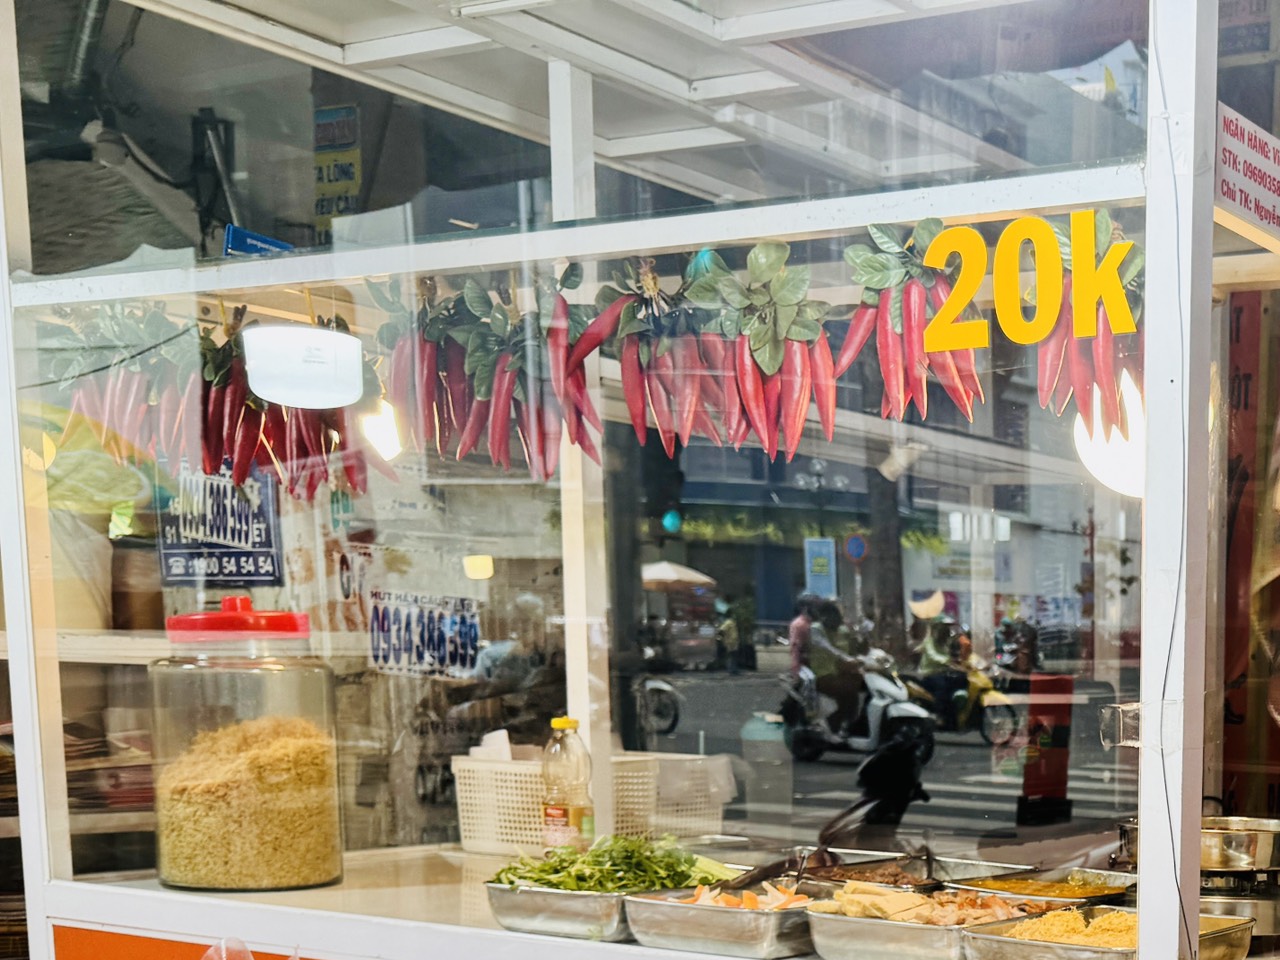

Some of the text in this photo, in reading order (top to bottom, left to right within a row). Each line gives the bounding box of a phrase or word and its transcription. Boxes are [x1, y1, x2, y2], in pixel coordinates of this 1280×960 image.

[1222, 116, 1245, 143] NGÂN
[1221, 147, 1241, 173] STK:
[1221, 179, 1236, 203] Chủ
[1238, 188, 1252, 212] TK:
[1254, 197, 1280, 228] Nguyễn
[922, 207, 1138, 353] 20k
[222, 556, 237, 574] 54
[240, 556, 255, 574] 54
[258, 556, 273, 574] 54
